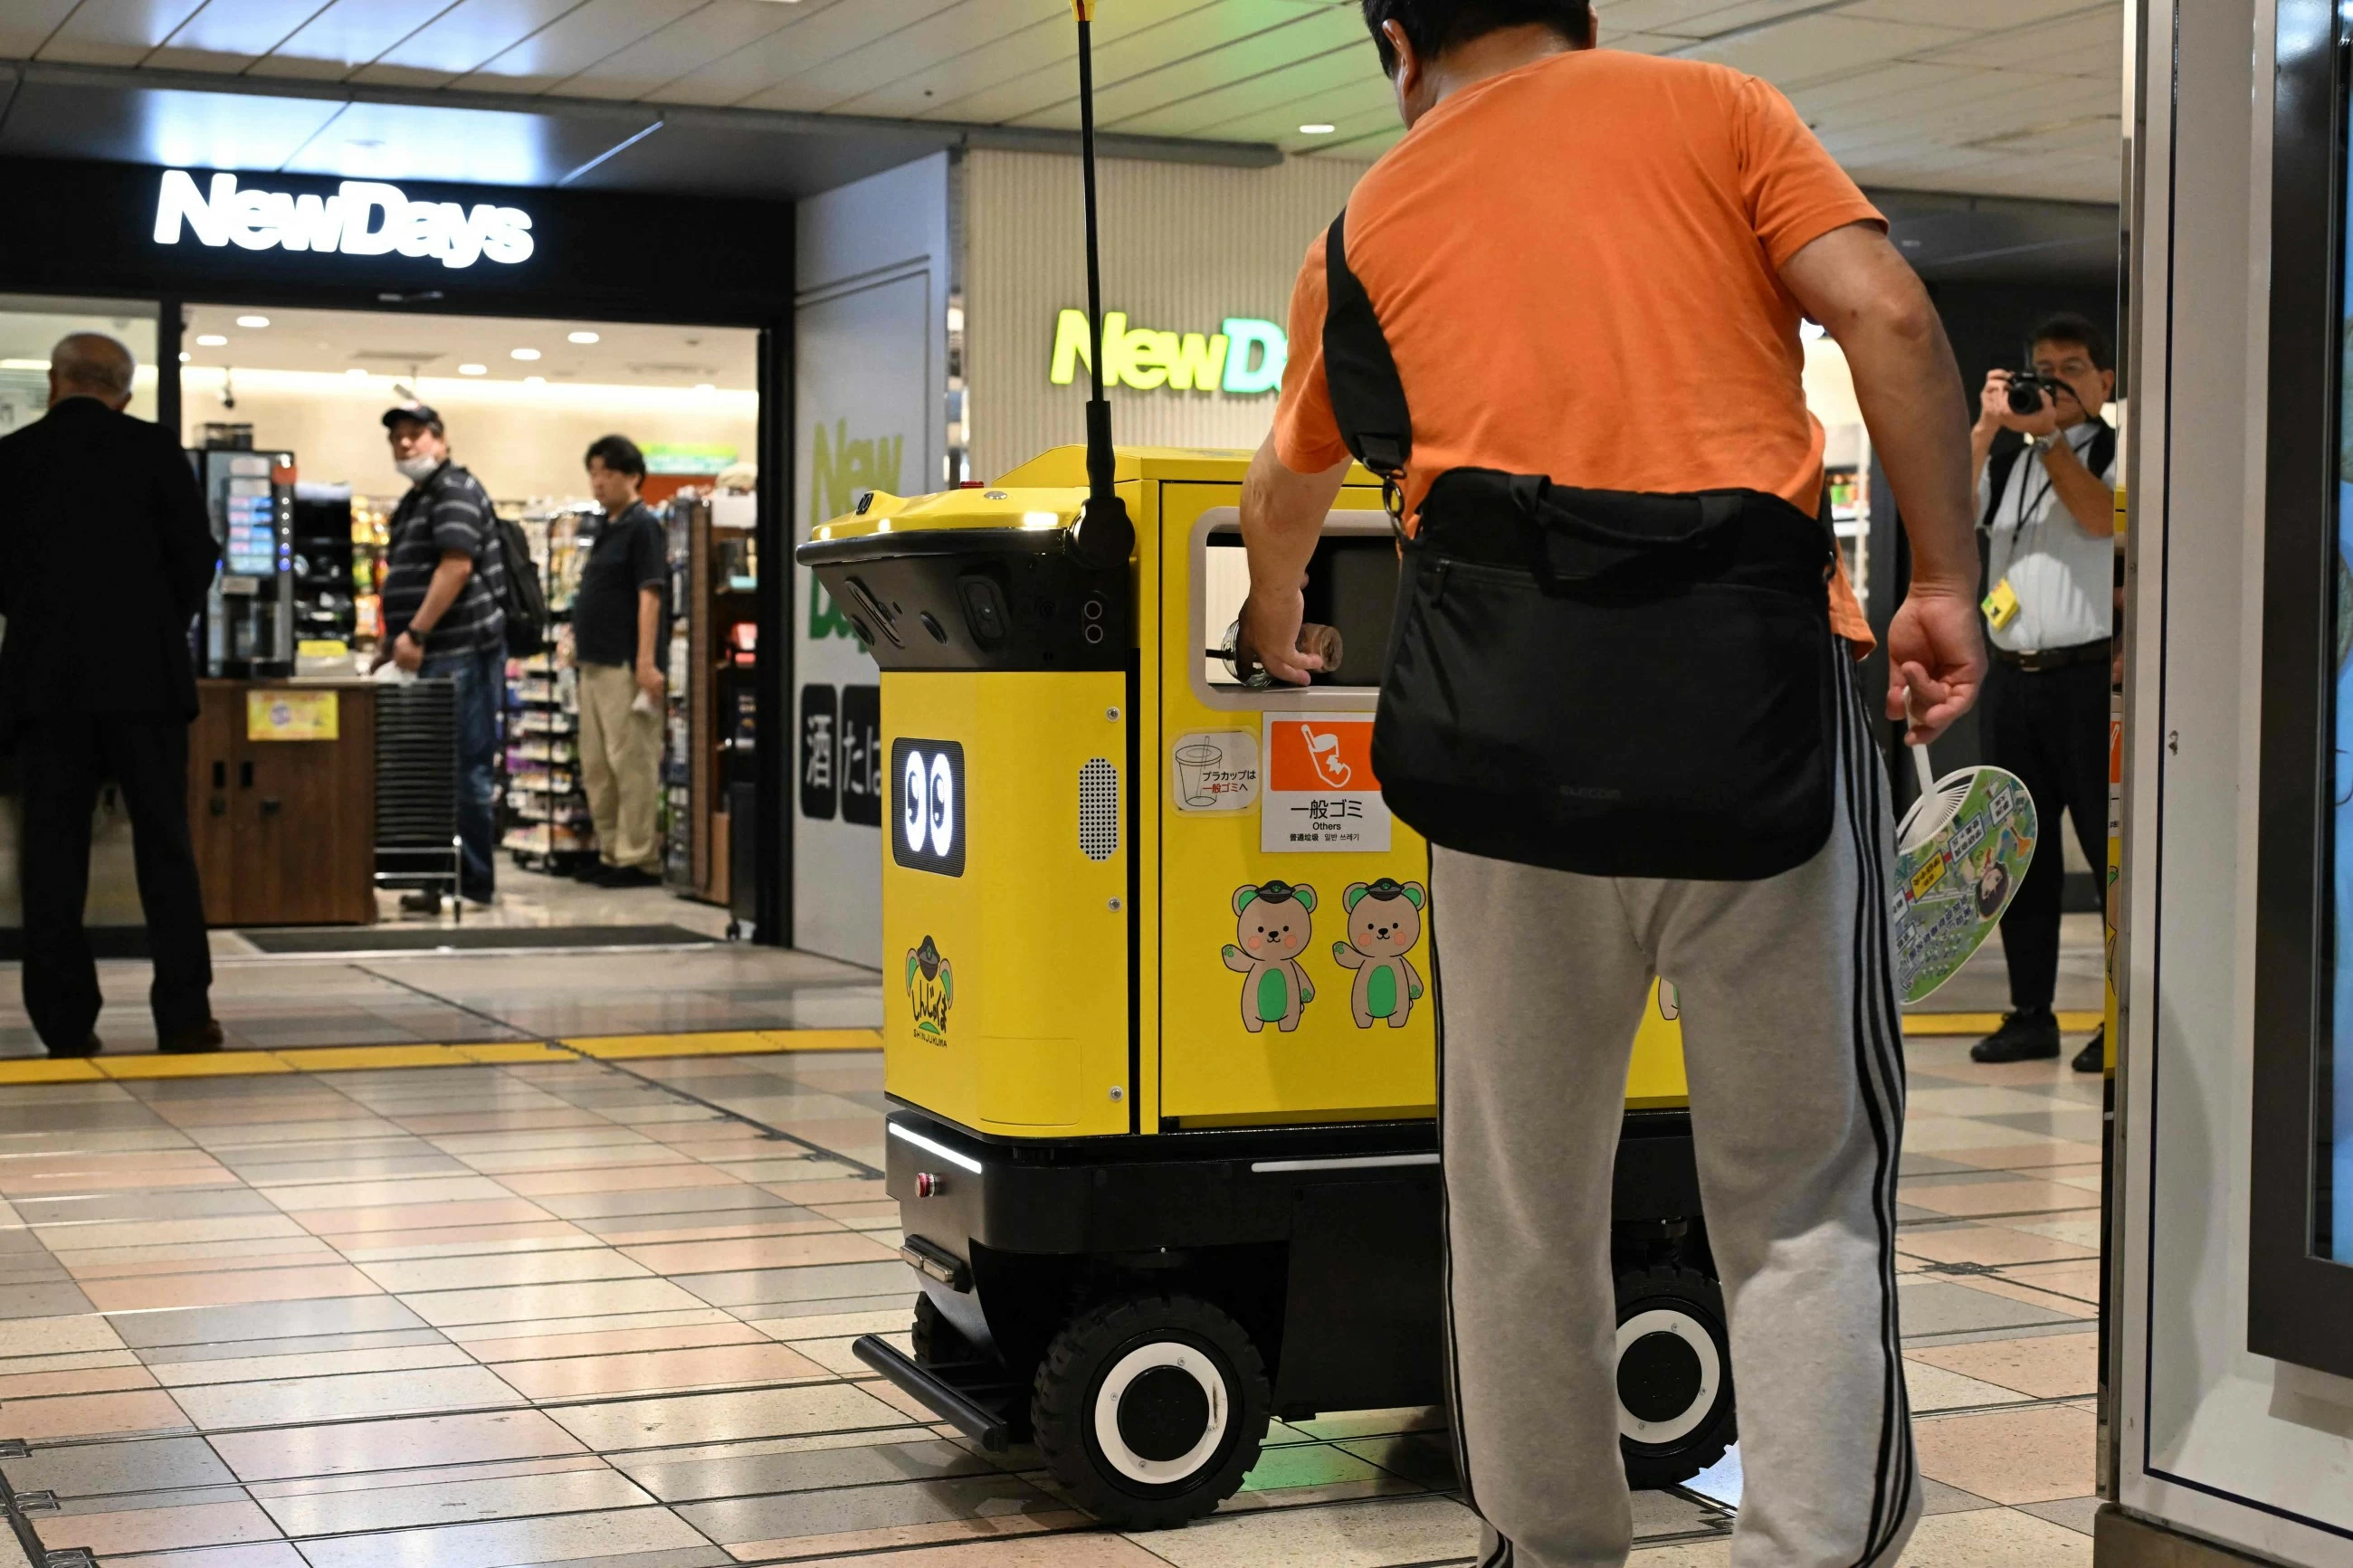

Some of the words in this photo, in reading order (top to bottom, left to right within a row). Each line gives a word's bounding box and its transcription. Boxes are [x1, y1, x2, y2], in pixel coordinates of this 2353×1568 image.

[153, 169, 534, 269] NewDays
[1051, 309, 1288, 393] NewD
[806, 715, 832, 788] 酒
[1202, 770, 1256, 782] プラカップは
[1291, 799, 1363, 819] 一般ゴミ
[1312, 822, 1341, 831] Others
